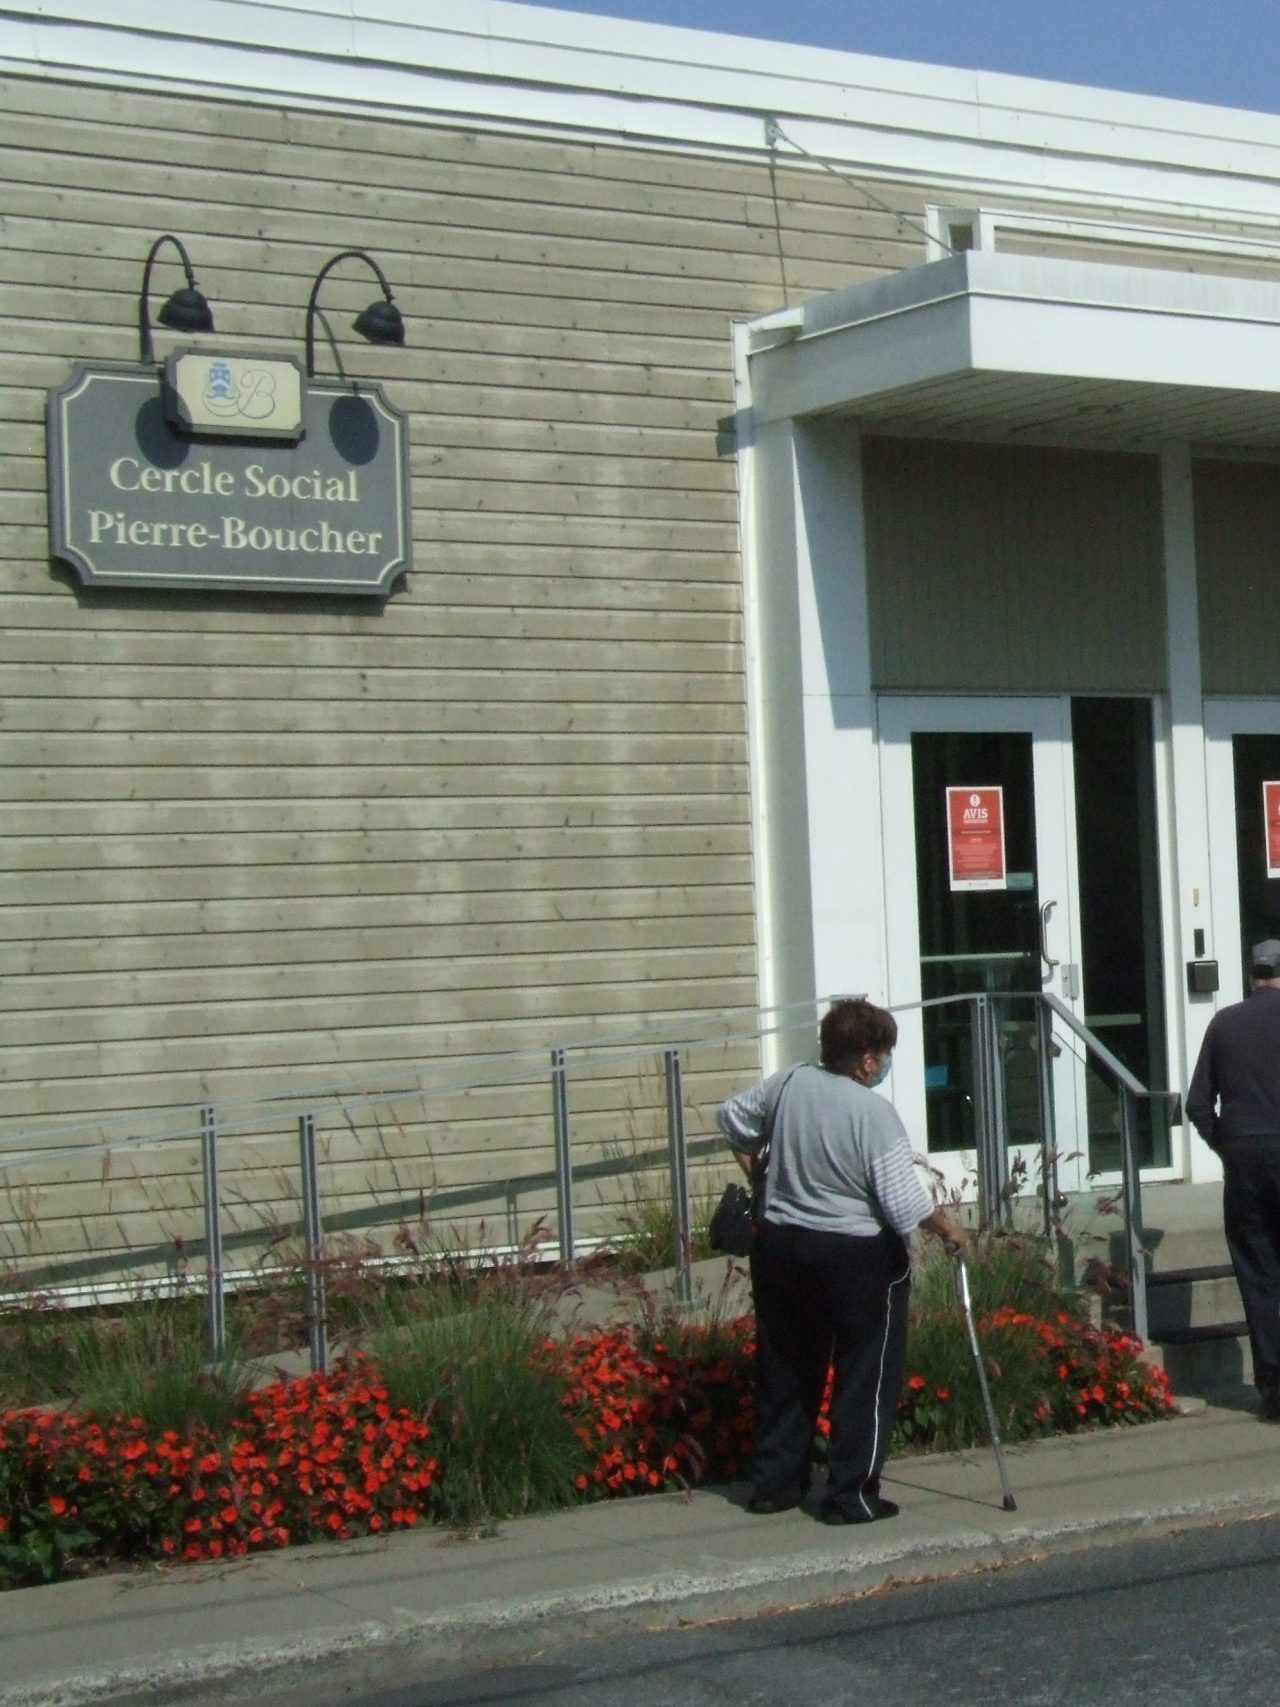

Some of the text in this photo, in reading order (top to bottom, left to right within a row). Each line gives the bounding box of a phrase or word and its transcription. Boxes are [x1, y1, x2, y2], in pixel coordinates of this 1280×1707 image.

[109, 457, 361, 502] Cercle Social
[87, 509, 383, 554] Pierre-Boucher
[963, 808, 988, 819] AVIS
